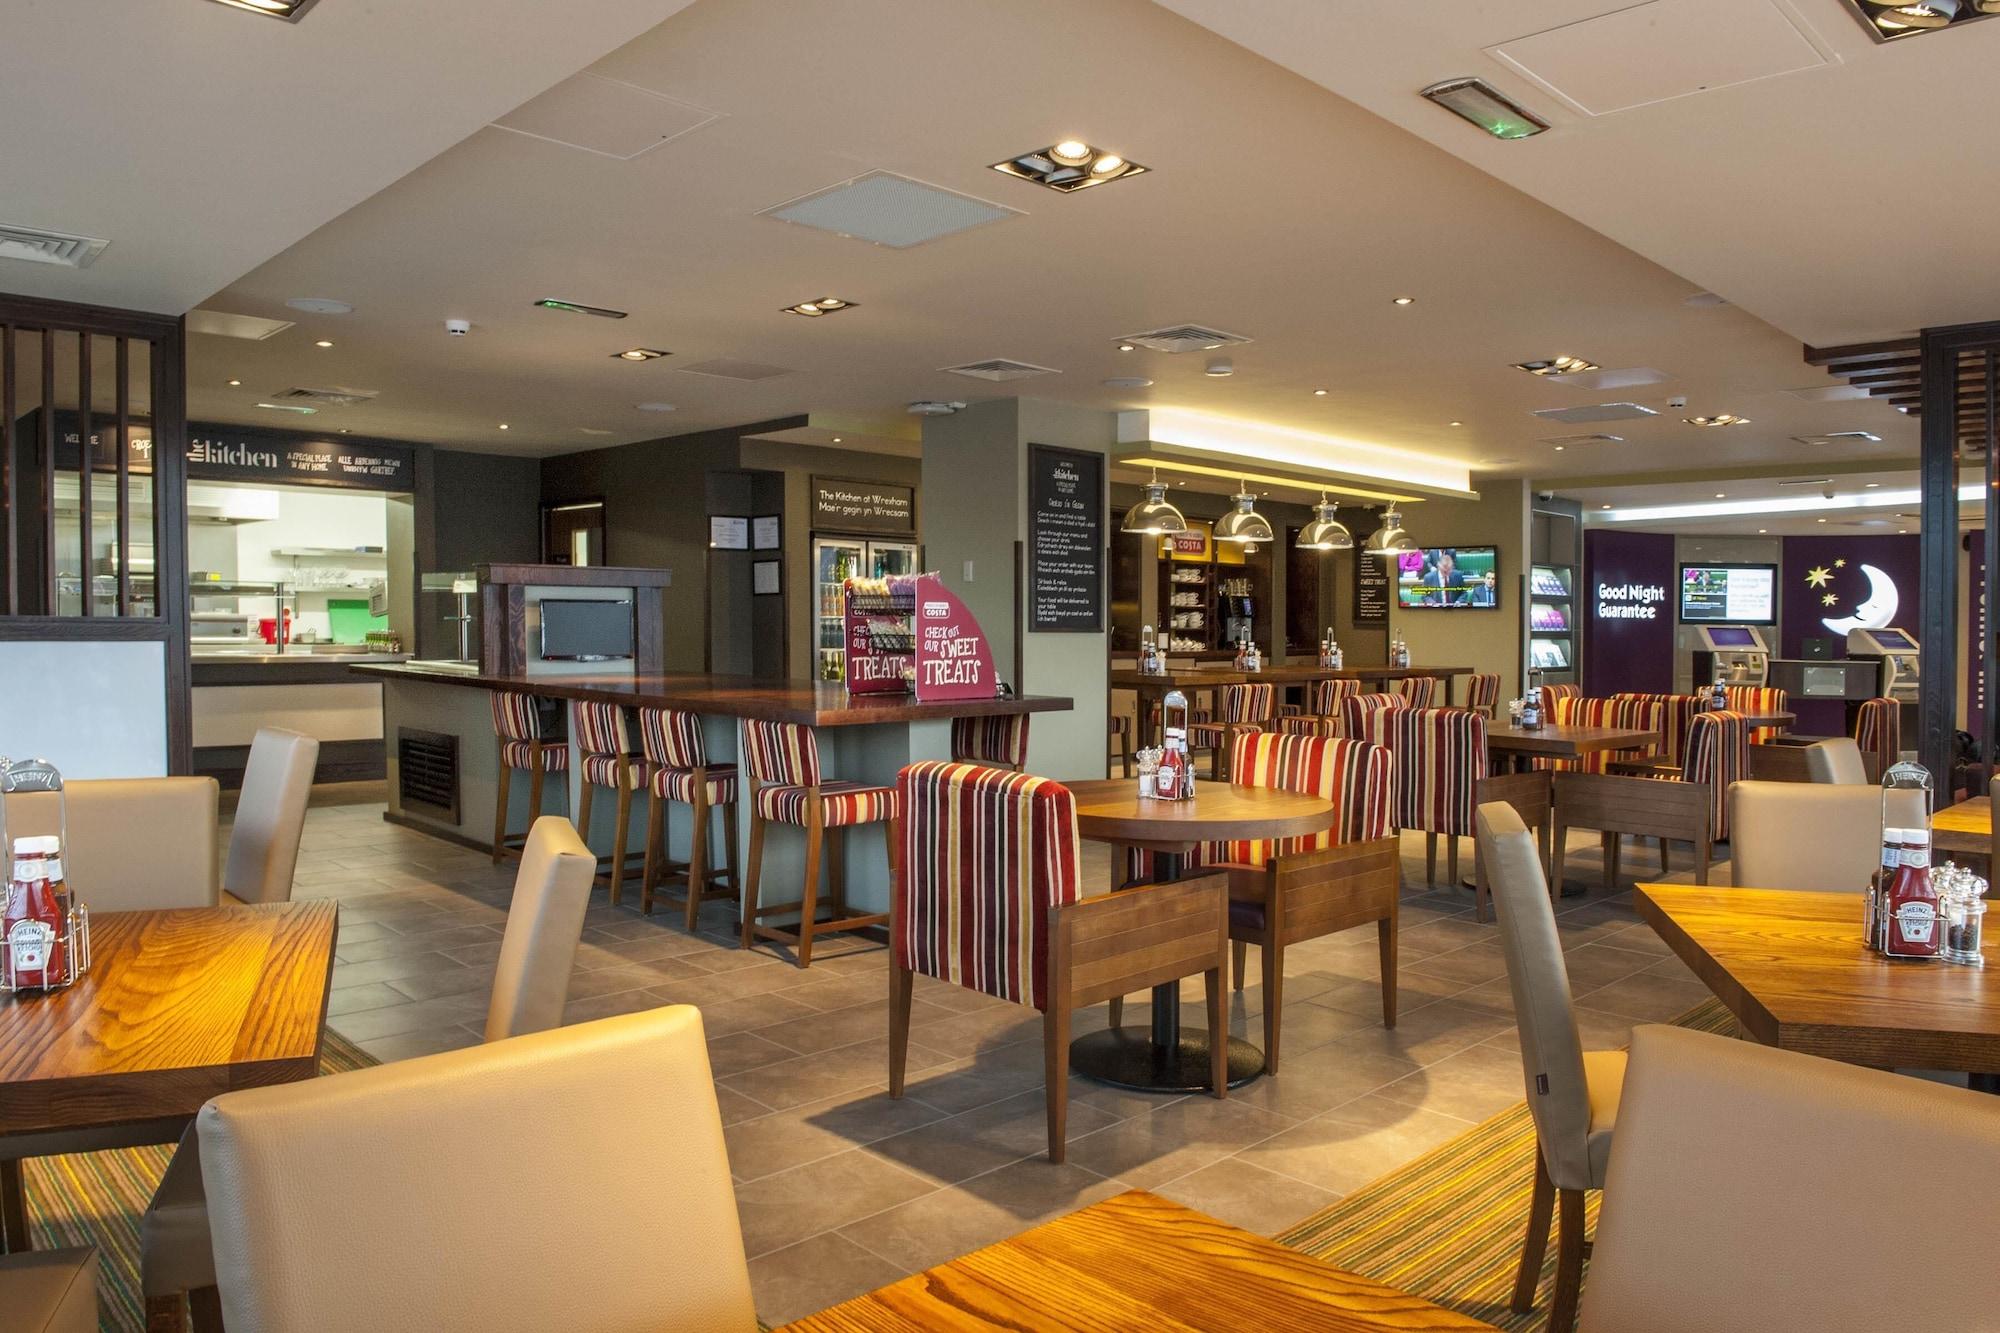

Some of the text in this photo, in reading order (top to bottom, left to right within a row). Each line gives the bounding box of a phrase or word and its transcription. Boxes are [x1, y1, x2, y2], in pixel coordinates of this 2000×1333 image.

[205, 440, 278, 468] kitchen
[820, 489, 908, 506] The Kitchen at Wrexham
[863, 507, 872, 517] yn
[873, 506, 909, 517] Wrecsam
[1178, 540, 1202, 551] COSTA
[1599, 583, 1665, 604] Good Night
[926, 609, 947, 617] COSTA
[1599, 601, 1656, 619] Guarantee
[924, 625, 960, 639] CHECK OUT
[924, 637, 979, 658] OUR SWEET
[852, 655, 906, 681] TREATS
[923, 659, 981, 686] TREATS
